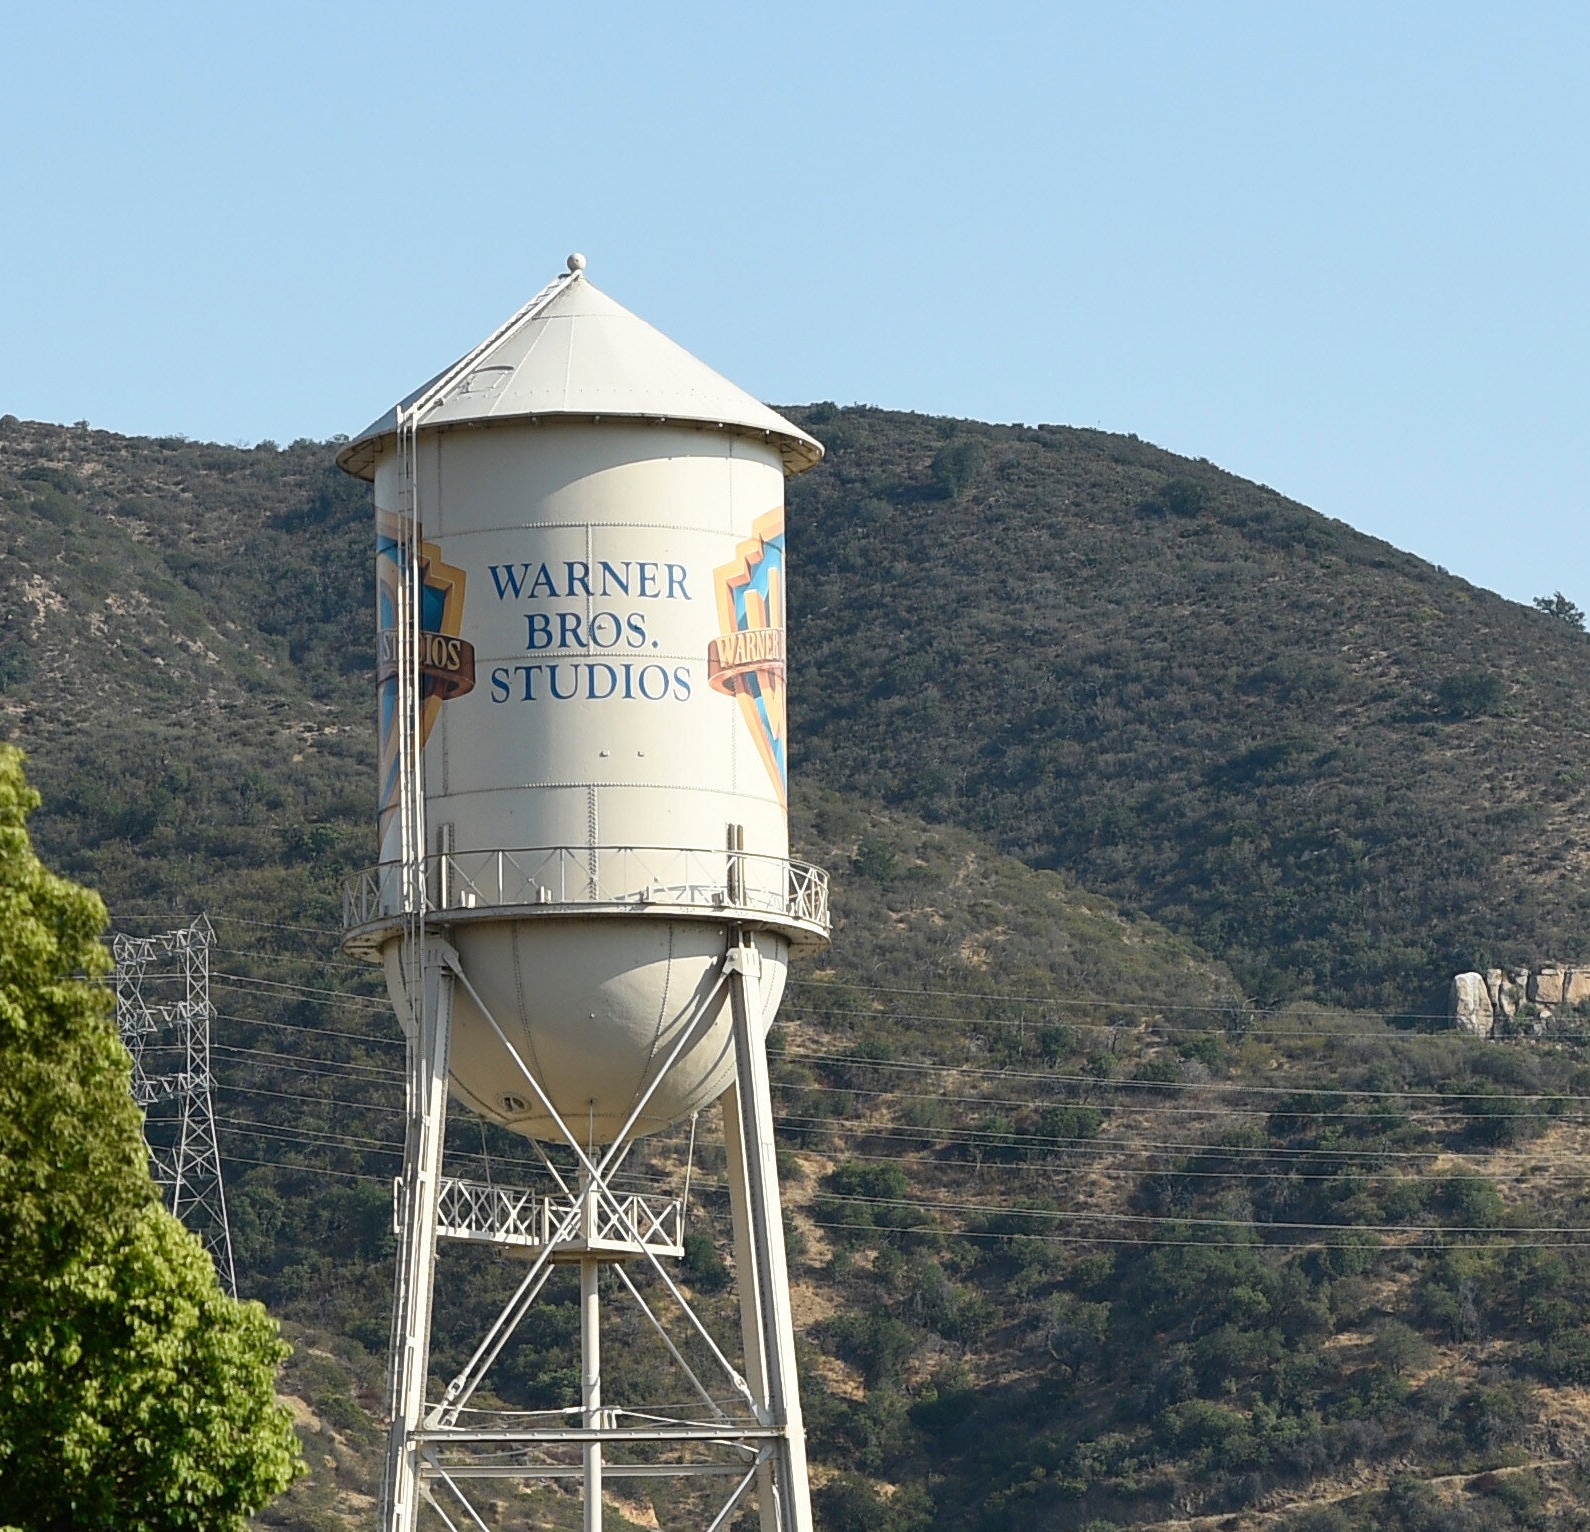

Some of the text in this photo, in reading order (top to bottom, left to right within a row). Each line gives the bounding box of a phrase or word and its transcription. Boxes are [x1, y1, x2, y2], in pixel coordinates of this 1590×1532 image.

[487, 560, 693, 600] WARNER
[523, 611, 659, 650] BROS.
[715, 629, 780, 668] WARNER
[382, 631, 461, 671] STIOS
[490, 663, 692, 704] STUDIOS
